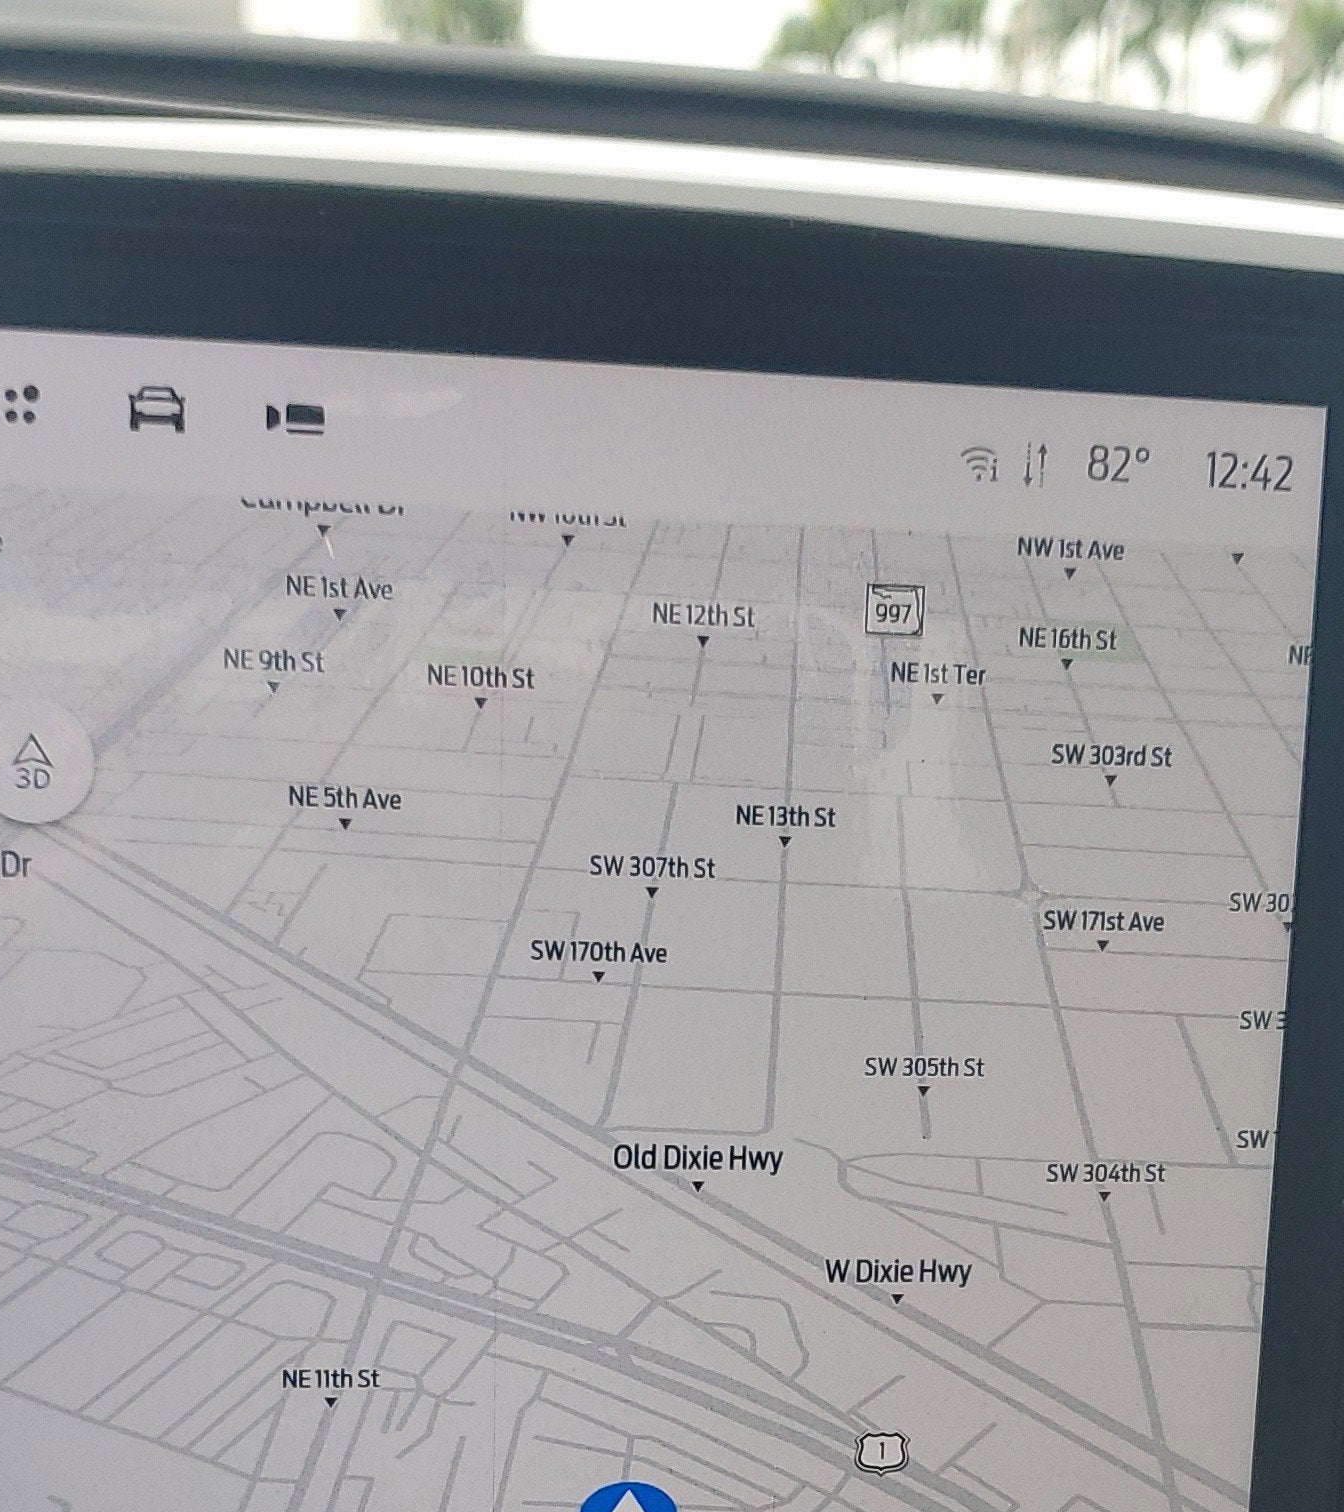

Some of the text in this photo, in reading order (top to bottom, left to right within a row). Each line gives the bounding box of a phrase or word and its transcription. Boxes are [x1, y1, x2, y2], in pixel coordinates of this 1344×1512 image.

[1087, 444, 1151, 483] 82°
[1206, 450, 1294, 492] 12:42
[1017, 537, 1125, 561] NW 1st Ave
[286, 575, 394, 600] NE 1st Ave
[653, 602, 756, 628] NE 12th St
[875, 603, 912, 624] 997
[1020, 627, 1118, 652] NE 16th St
[223, 648, 325, 673] NE 9th St
[427, 664, 535, 690] NE 10th St
[891, 661, 987, 686] NE 1st Ter
[1051, 744, 1173, 768] SW 303rd St
[15, 767, 51, 790] 3D
[288, 785, 402, 811] NE 5th Ave
[736, 804, 837, 828] NE 13th St
[1, 850, 33, 878] Dr
[589, 855, 716, 879] SW 307th St
[1228, 892, 1263, 913] SW
[1043, 909, 1165, 932] SW 171st Ave
[531, 940, 668, 963] SW 170th Ave
[1239, 1010, 1272, 1030] SW
[864, 1057, 985, 1078] SW 305th St
[1236, 1130, 1269, 1149] SW
[613, 1145, 784, 1176] Old Dixie Hwy
[1046, 1164, 1166, 1183] SW 304th St
[824, 1259, 973, 1288] W Dixie Hwy
[282, 1368, 380, 1389] NE 11th St
